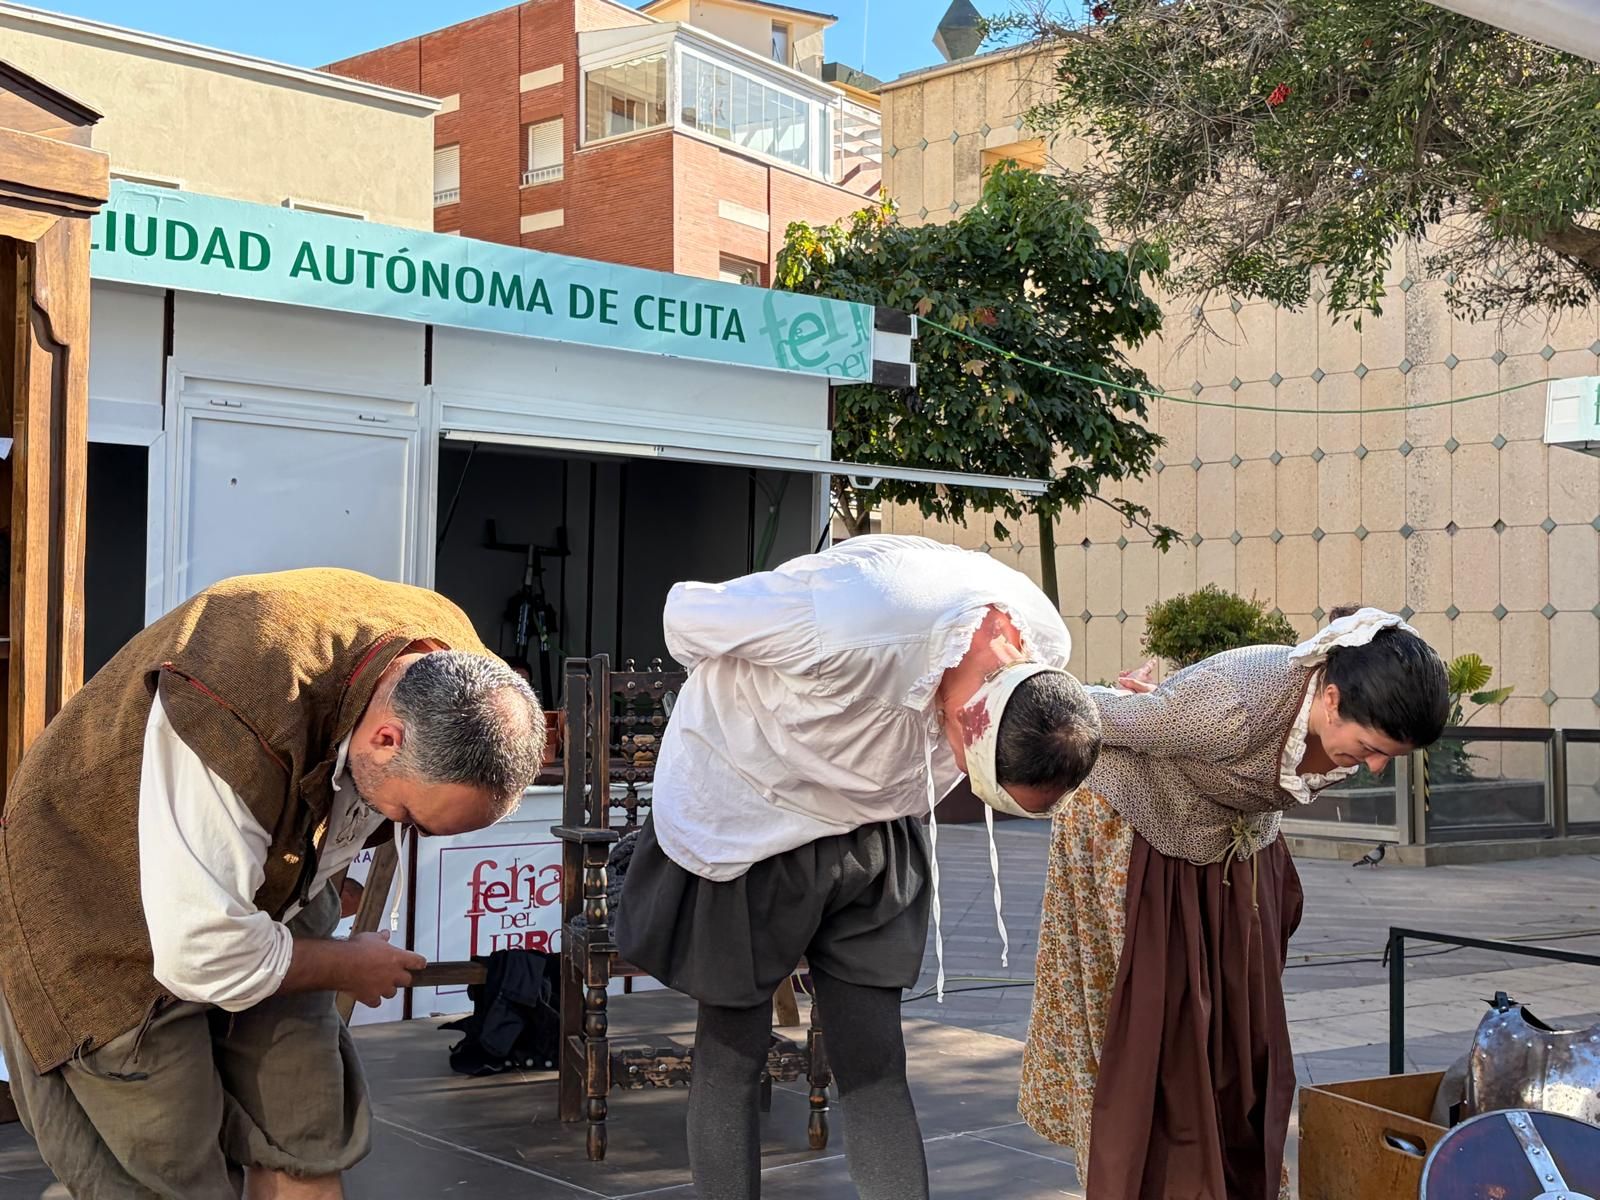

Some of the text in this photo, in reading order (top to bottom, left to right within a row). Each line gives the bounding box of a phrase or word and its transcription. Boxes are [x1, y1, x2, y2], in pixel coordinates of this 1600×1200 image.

[90, 210, 747, 343] IUDAD AUTÓNOMA DE CEUTA
[466, 857, 563, 914] feria
